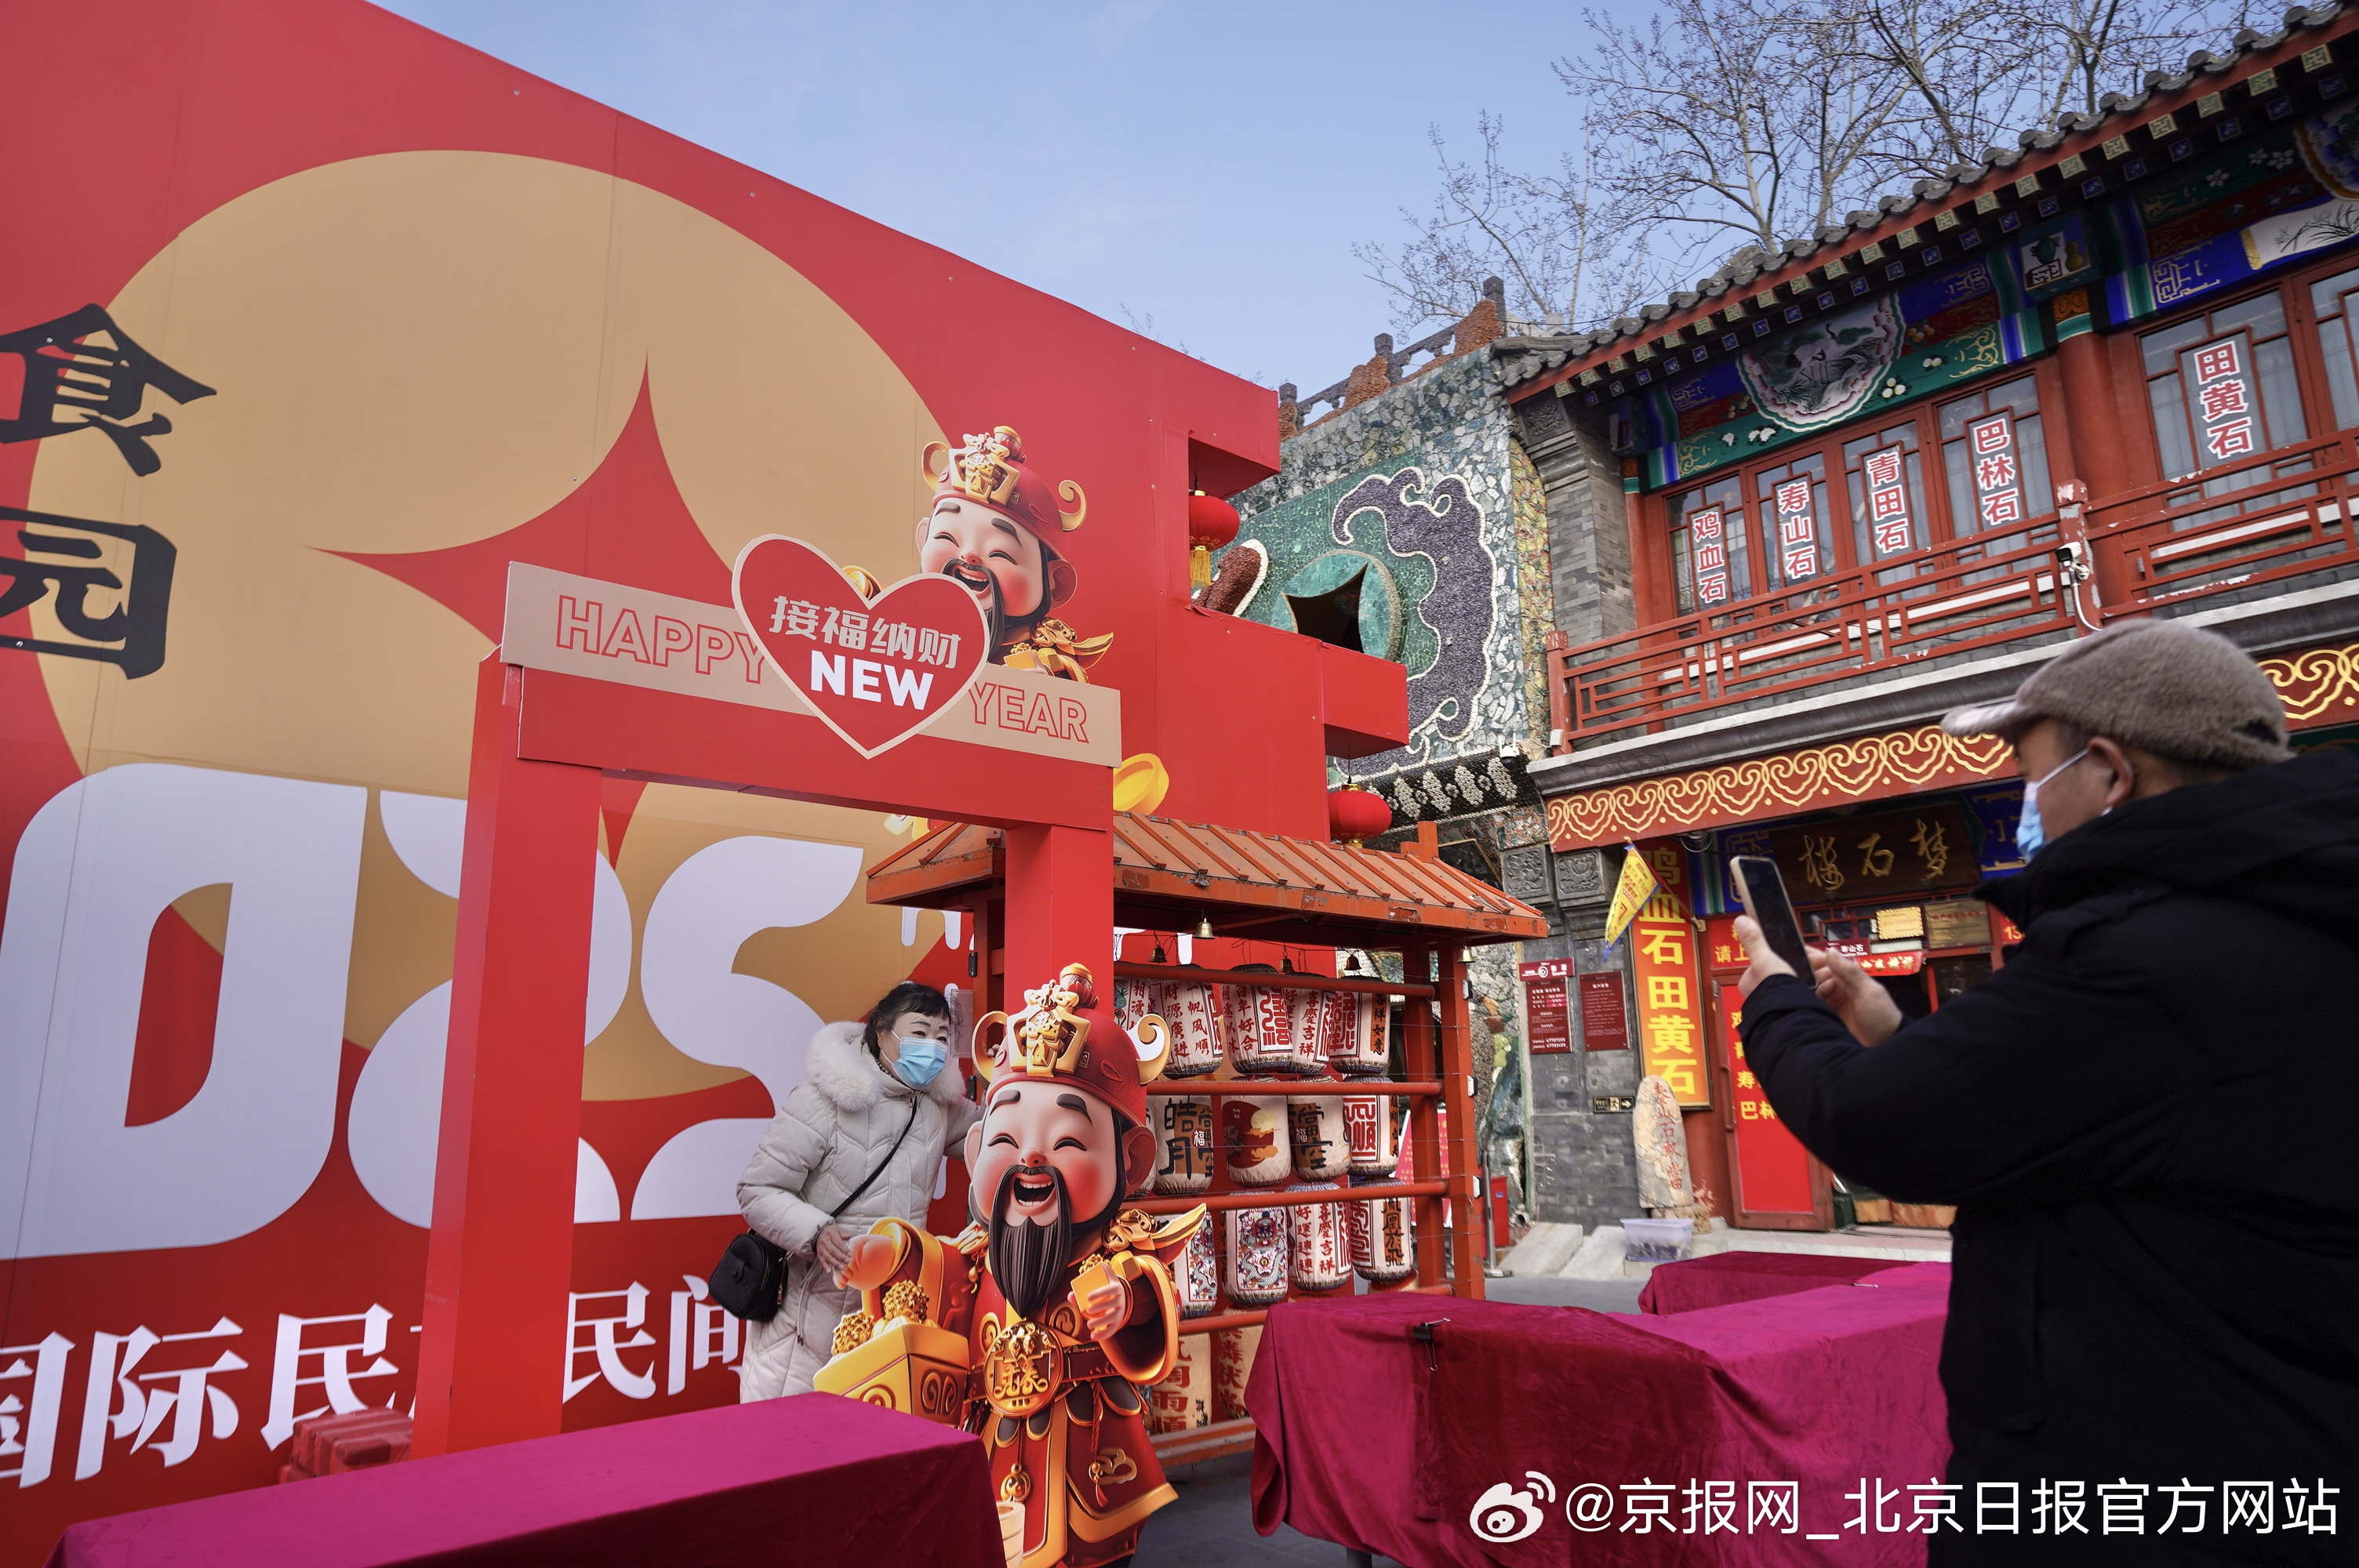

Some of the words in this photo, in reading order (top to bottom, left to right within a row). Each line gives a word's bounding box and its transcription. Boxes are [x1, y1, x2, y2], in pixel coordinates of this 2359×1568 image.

[2193, 340, 2253, 459] 田黄石
[1866, 450, 1910, 554] 青田石
[1972, 417, 2020, 526] 巴林石
[1692, 511, 1727, 604] 鸡血石
[1778, 481, 1816, 579] 寿山石
[556, 595, 768, 684] HAPPY
[809, 652, 934, 711] NEW
[968, 681, 1089, 744] YEAR
[769, 595, 962, 670] 接福纳财
[1187, 985, 1209, 1055] 一帆風順
[1235, 984, 1258, 1051] 百年好合
[1299, 989, 1320, 1058] 喜慶吉祥
[1296, 1206, 1314, 1275] 好運連連
[1318, 1202, 1336, 1274] 喜慶吉祥
[0, 1274, 747, 1489] 国际民民间
